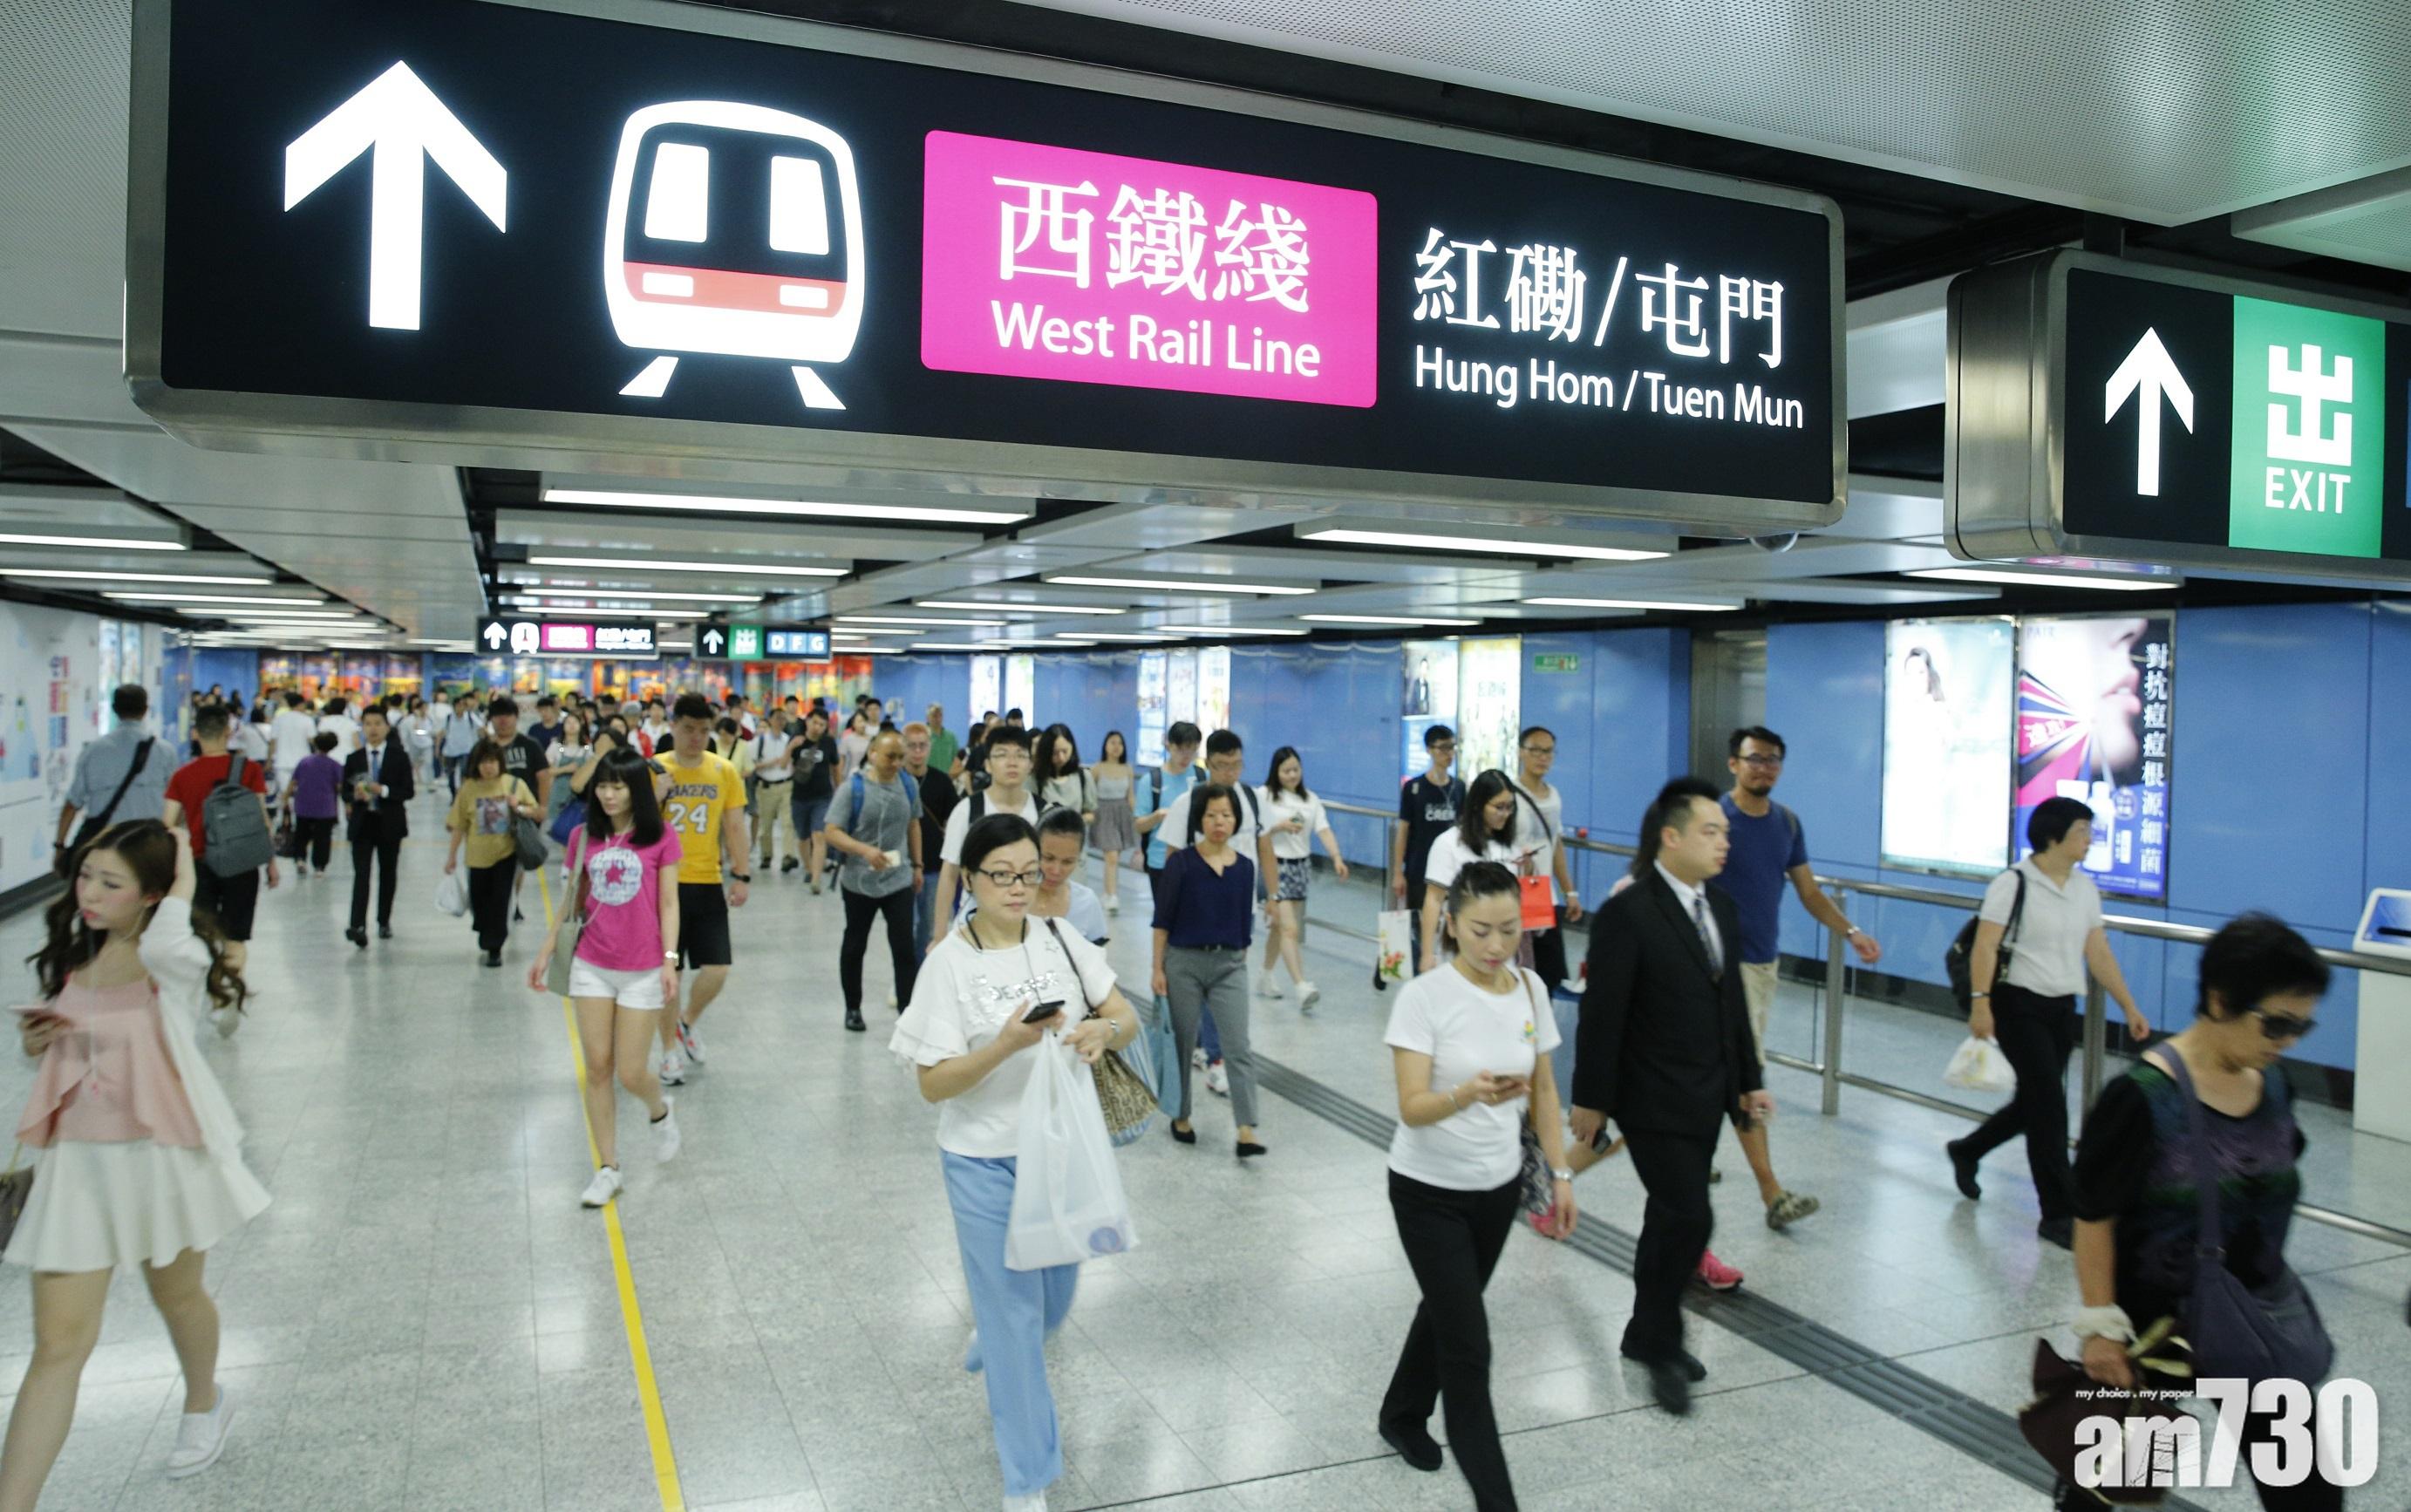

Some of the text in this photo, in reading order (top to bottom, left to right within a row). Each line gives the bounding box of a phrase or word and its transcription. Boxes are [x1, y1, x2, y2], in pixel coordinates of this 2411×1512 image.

[991, 175, 1311, 313] 西鐵綫
[991, 299, 1320, 377] West Rail Line
[1413, 227, 1785, 369] 紅磡/屯門
[1415, 344, 1518, 408] Hung
[1529, 358, 1614, 408] Hom
[1733, 383, 1803, 428] Mun
[2267, 344, 2353, 467] 出
[2265, 467, 2351, 514] EXIT
[771, 634, 785, 651] D
[792, 635, 803, 650] F
[811, 635, 825, 651] G
[668, 802, 708, 834] 24
